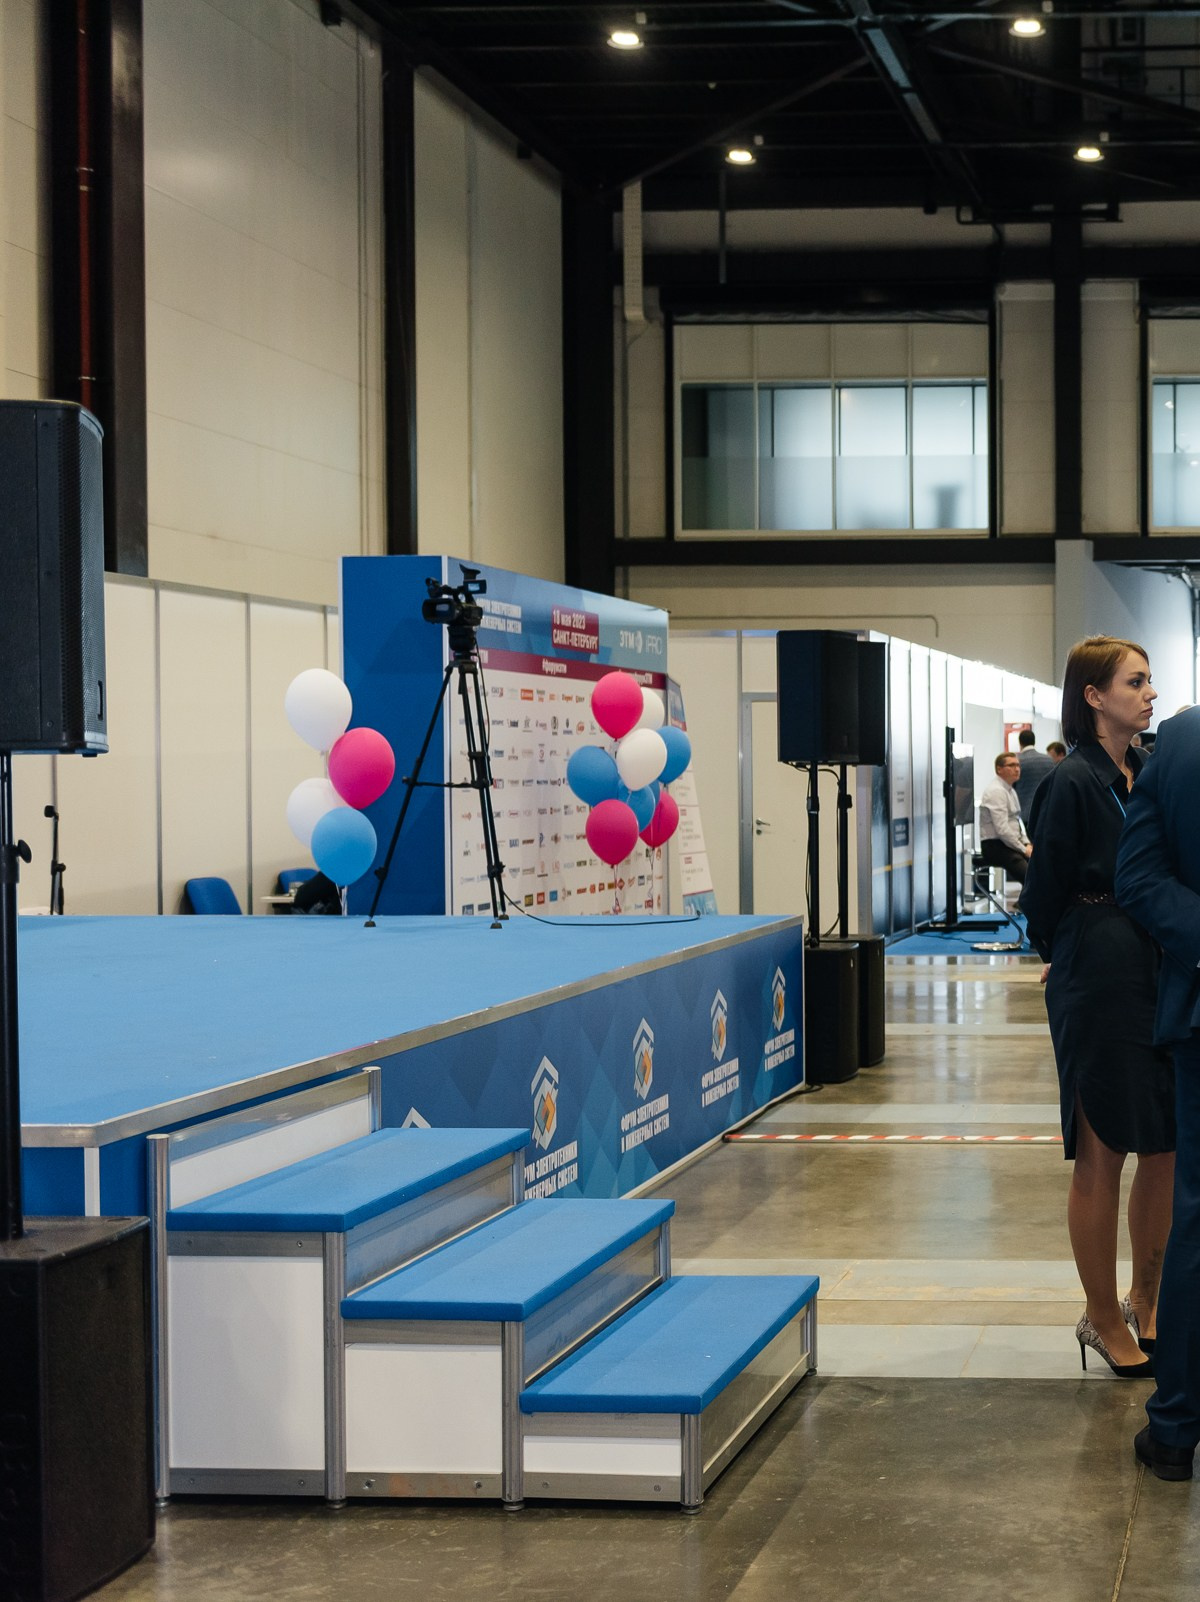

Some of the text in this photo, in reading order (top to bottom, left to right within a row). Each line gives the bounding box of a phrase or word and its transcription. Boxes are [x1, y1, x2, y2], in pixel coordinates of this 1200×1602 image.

[552, 608, 586, 630] 18 мая 2023
[552, 628, 599, 651] САНКТ-ПЕТЕРБУРГ
[619, 630, 635, 650] ЭТМ
[701, 1069, 713, 1089] ФОРУМ
[621, 1093, 669, 1132] ФОРУМ ЭЛЕКТРОТЕХНИКИ
[621, 1112, 670, 1154] И ИНЖЕНЕРНЫХ СИСТЕМ
[524, 1140, 578, 1184] РУМ ЭЛЕКТРОТЕХНИКИ
[524, 1162, 578, 1200] НЖЕНЕРНЫХ СИСТЕМ
